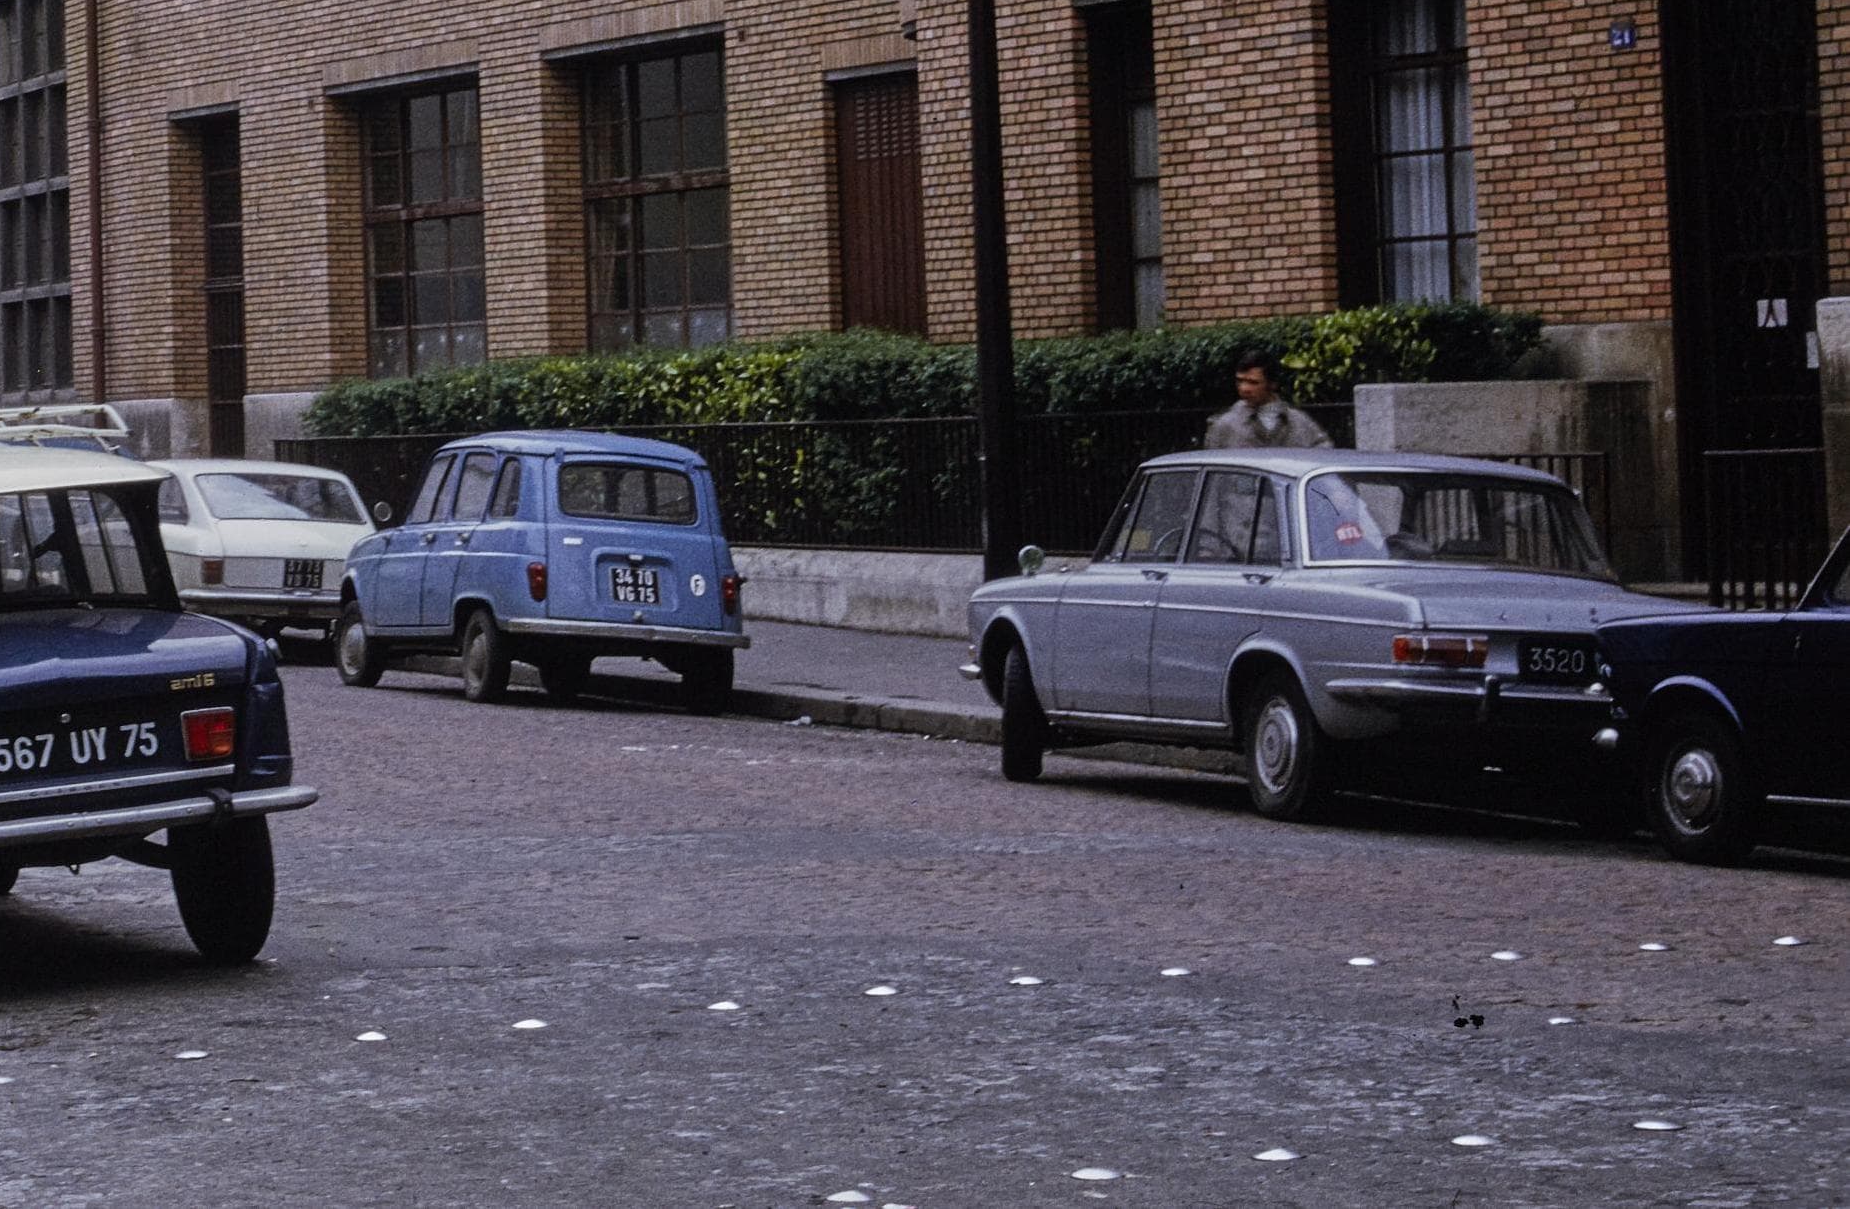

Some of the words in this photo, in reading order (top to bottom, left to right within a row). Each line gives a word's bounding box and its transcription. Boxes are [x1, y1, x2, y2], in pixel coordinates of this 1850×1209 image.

[615, 568, 634, 585] 34
[616, 585, 635, 602] VG
[637, 587, 655, 603] 75
[1529, 647, 1585, 674] 3520
[69, 726, 108, 764] UY
[119, 721, 159, 758] 75
